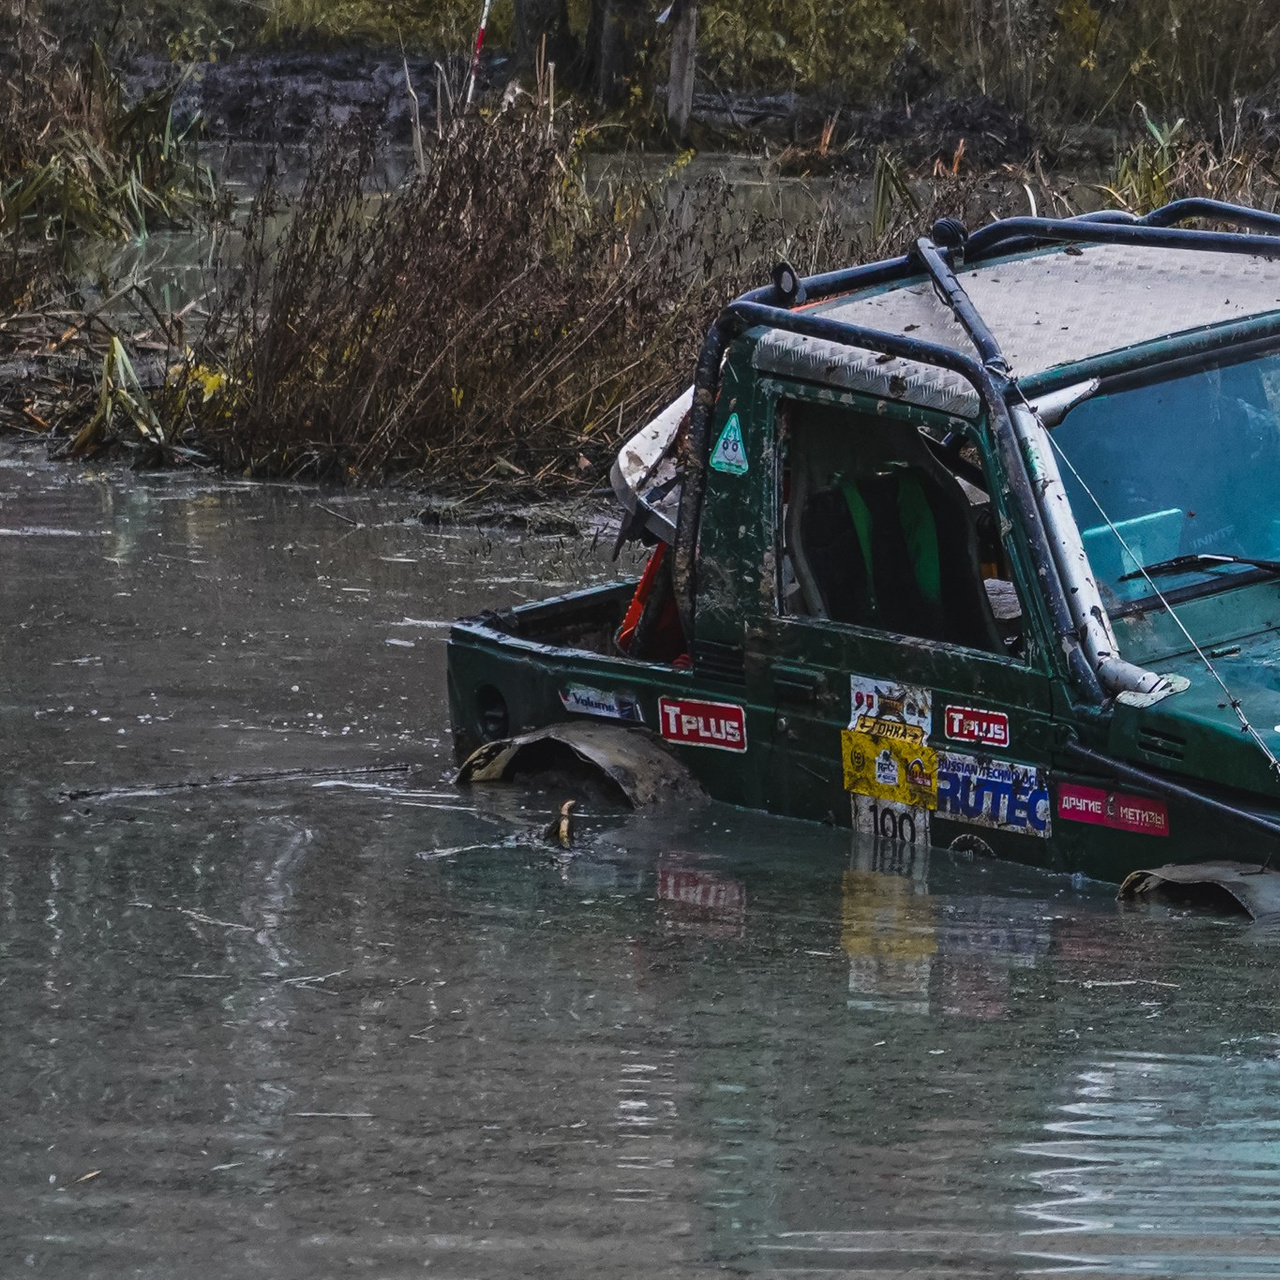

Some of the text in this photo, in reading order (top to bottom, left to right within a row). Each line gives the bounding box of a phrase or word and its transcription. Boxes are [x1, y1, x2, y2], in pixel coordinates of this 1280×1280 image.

[572, 692, 616, 714] Volume
[939, 760, 978, 777] RUSSIAN
[937, 770, 1048, 831] RUTEC
[1062, 796, 1102, 814] ДРУГИЕ
[1120, 806, 1165, 826] МЕТИЗЫ
[868, 804, 916, 844] 100
